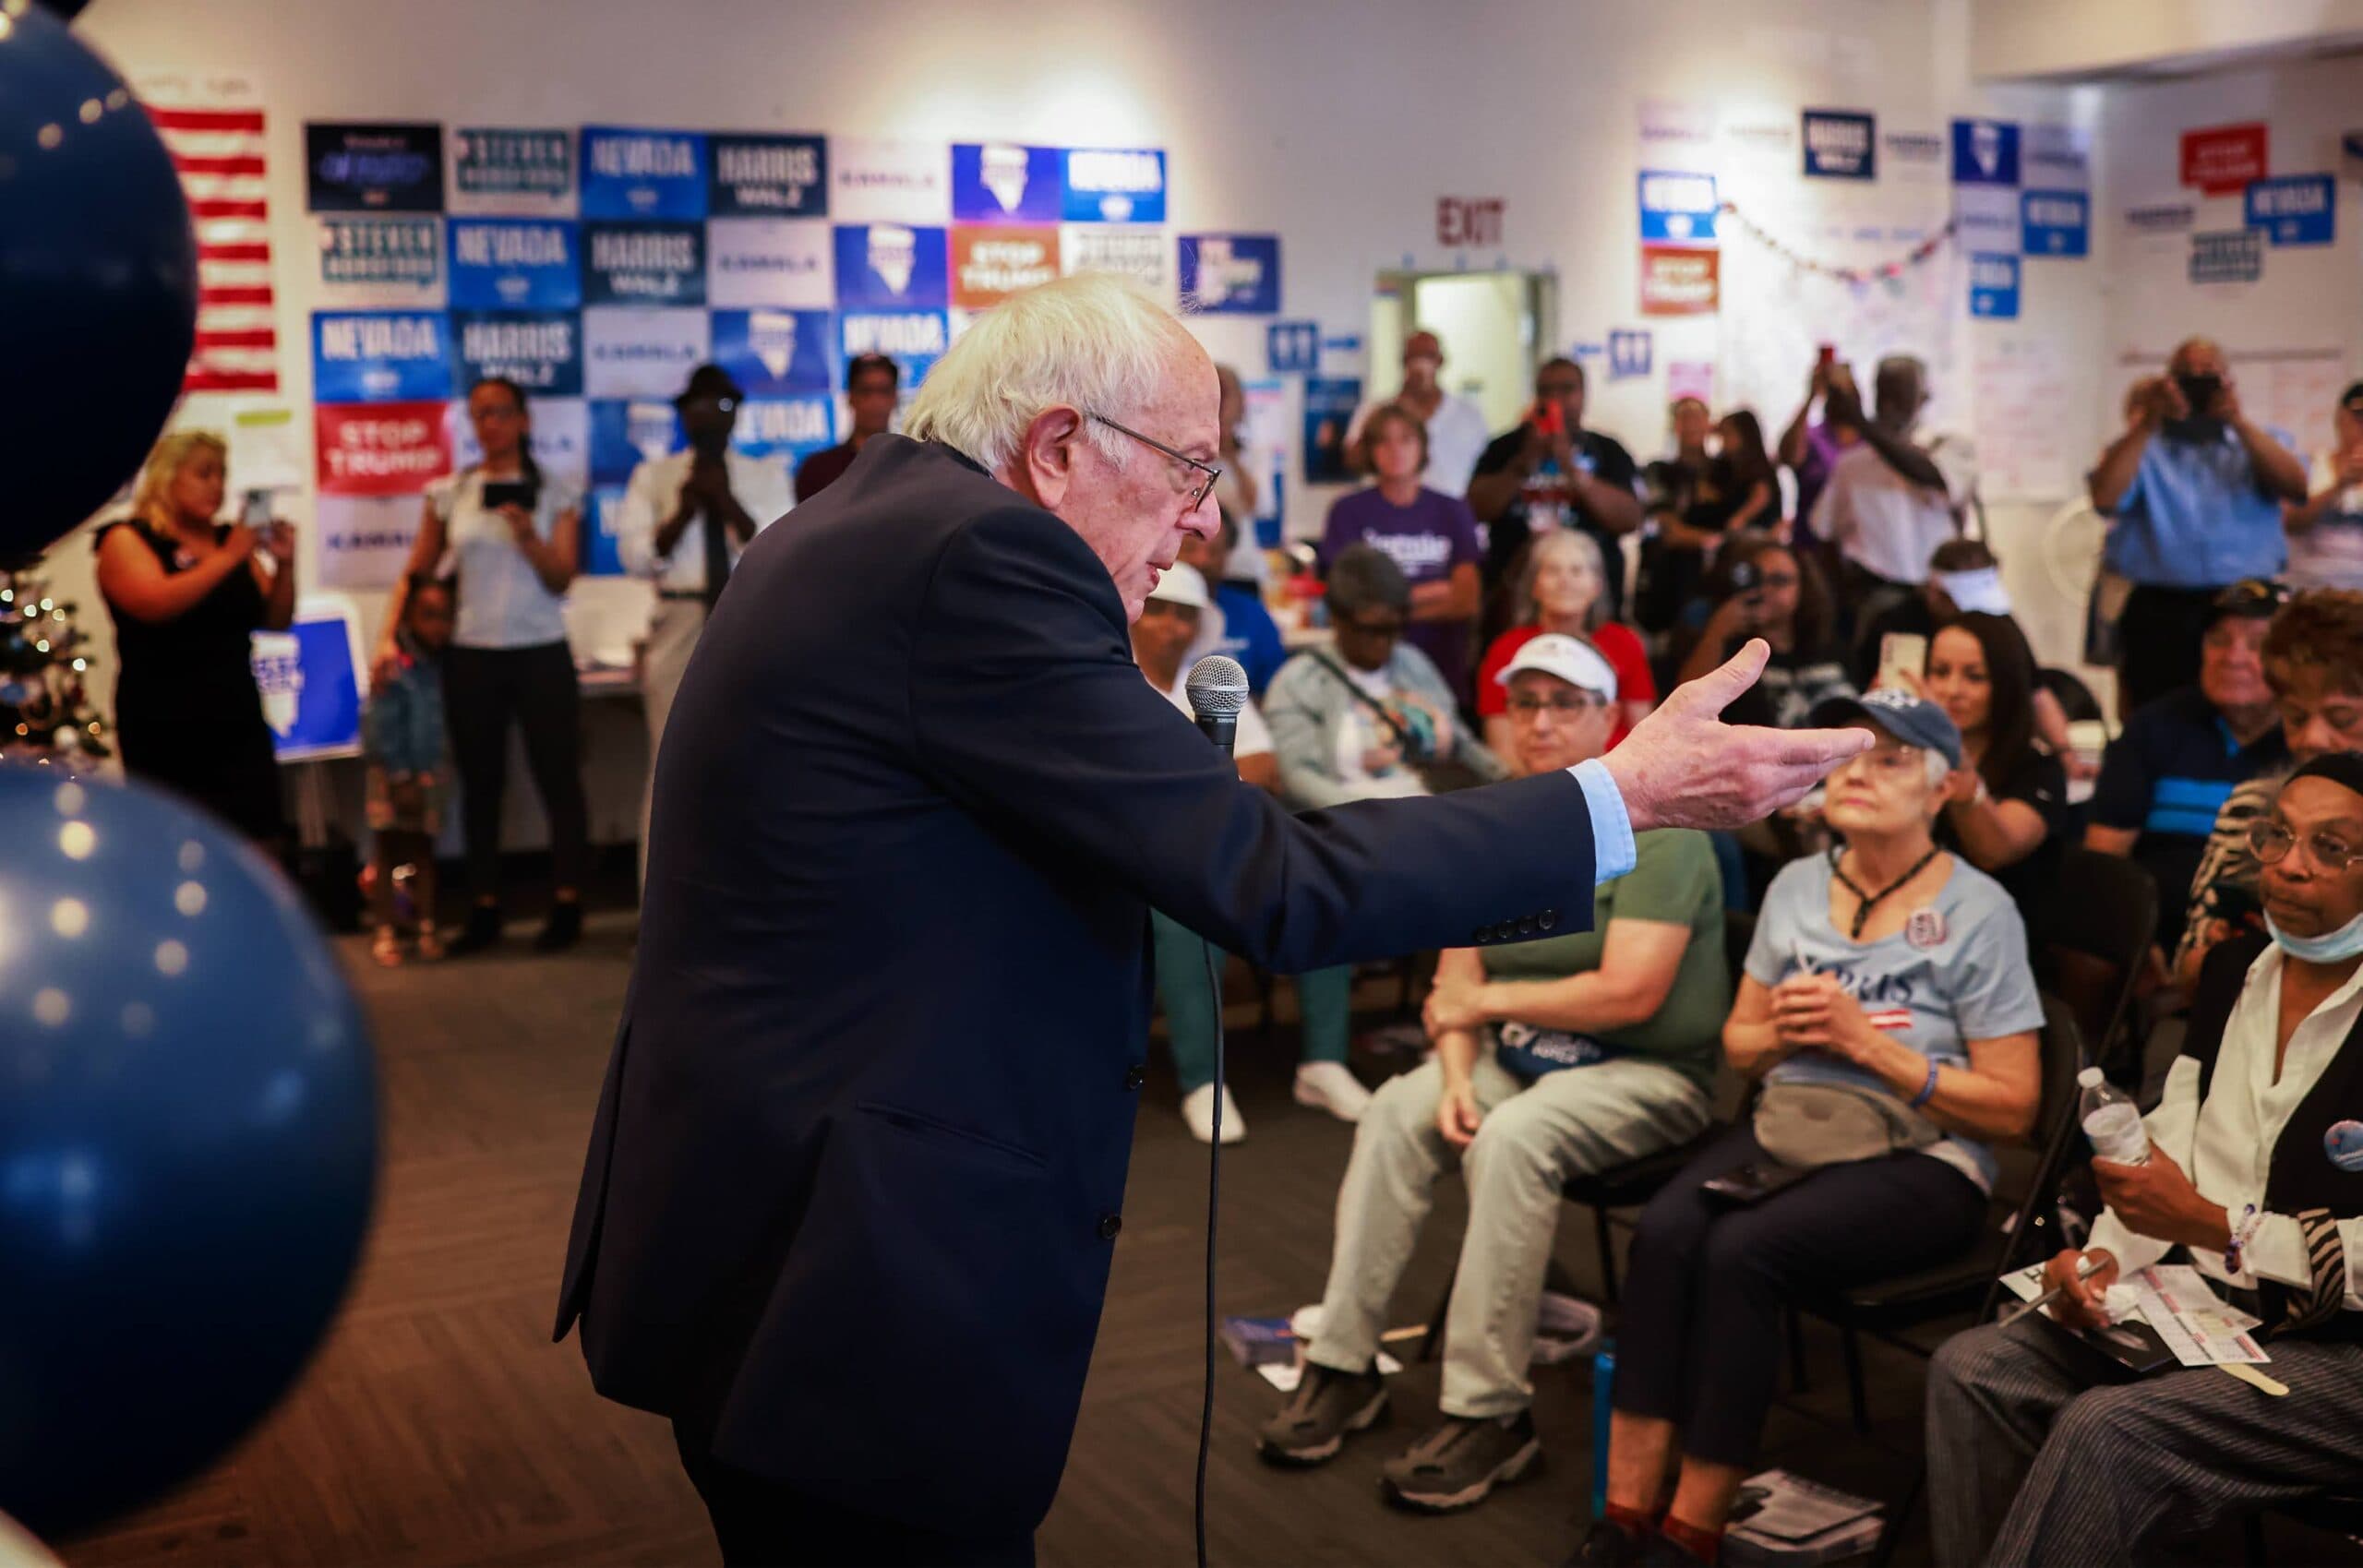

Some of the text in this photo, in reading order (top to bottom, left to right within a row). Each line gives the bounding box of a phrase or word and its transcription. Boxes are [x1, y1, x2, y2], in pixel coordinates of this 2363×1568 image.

[592, 138, 695, 177] NEVADA
[717, 146, 818, 186] HARRIS
[736, 185, 803, 209] WALZ
[1436, 197, 1505, 246] EXIT
[455, 224, 568, 267] NEVADA
[591, 233, 694, 272] HARRIS
[971, 242, 1044, 266] STOP
[608, 273, 680, 296] WALZ
[962, 266, 1055, 294] TRUMP
[321, 318, 438, 359] NEVADA
[463, 323, 571, 363] HARRIS
[340, 419, 427, 448] STOP
[327, 449, 442, 475] TRUMP
